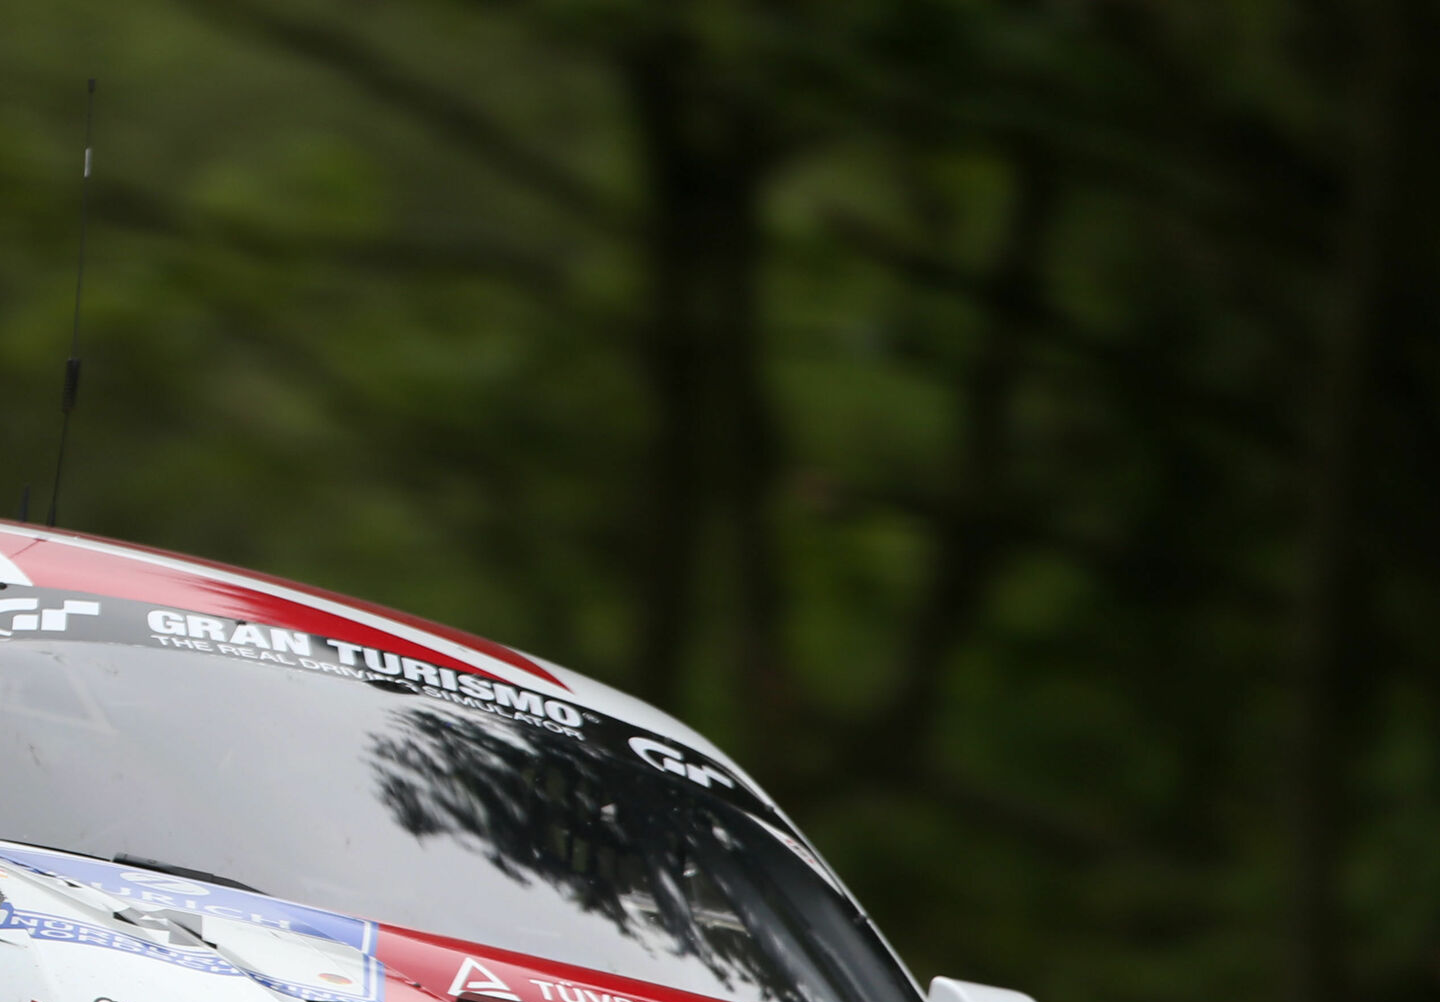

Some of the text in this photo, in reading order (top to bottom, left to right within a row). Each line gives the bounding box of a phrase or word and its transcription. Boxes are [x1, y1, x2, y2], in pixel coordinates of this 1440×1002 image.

[146, 609, 585, 728] GRAN TURISMO
[150, 634, 214, 653] THE
[216, 643, 297, 667] REAL
[422, 684, 586, 741] SIMULATOR
